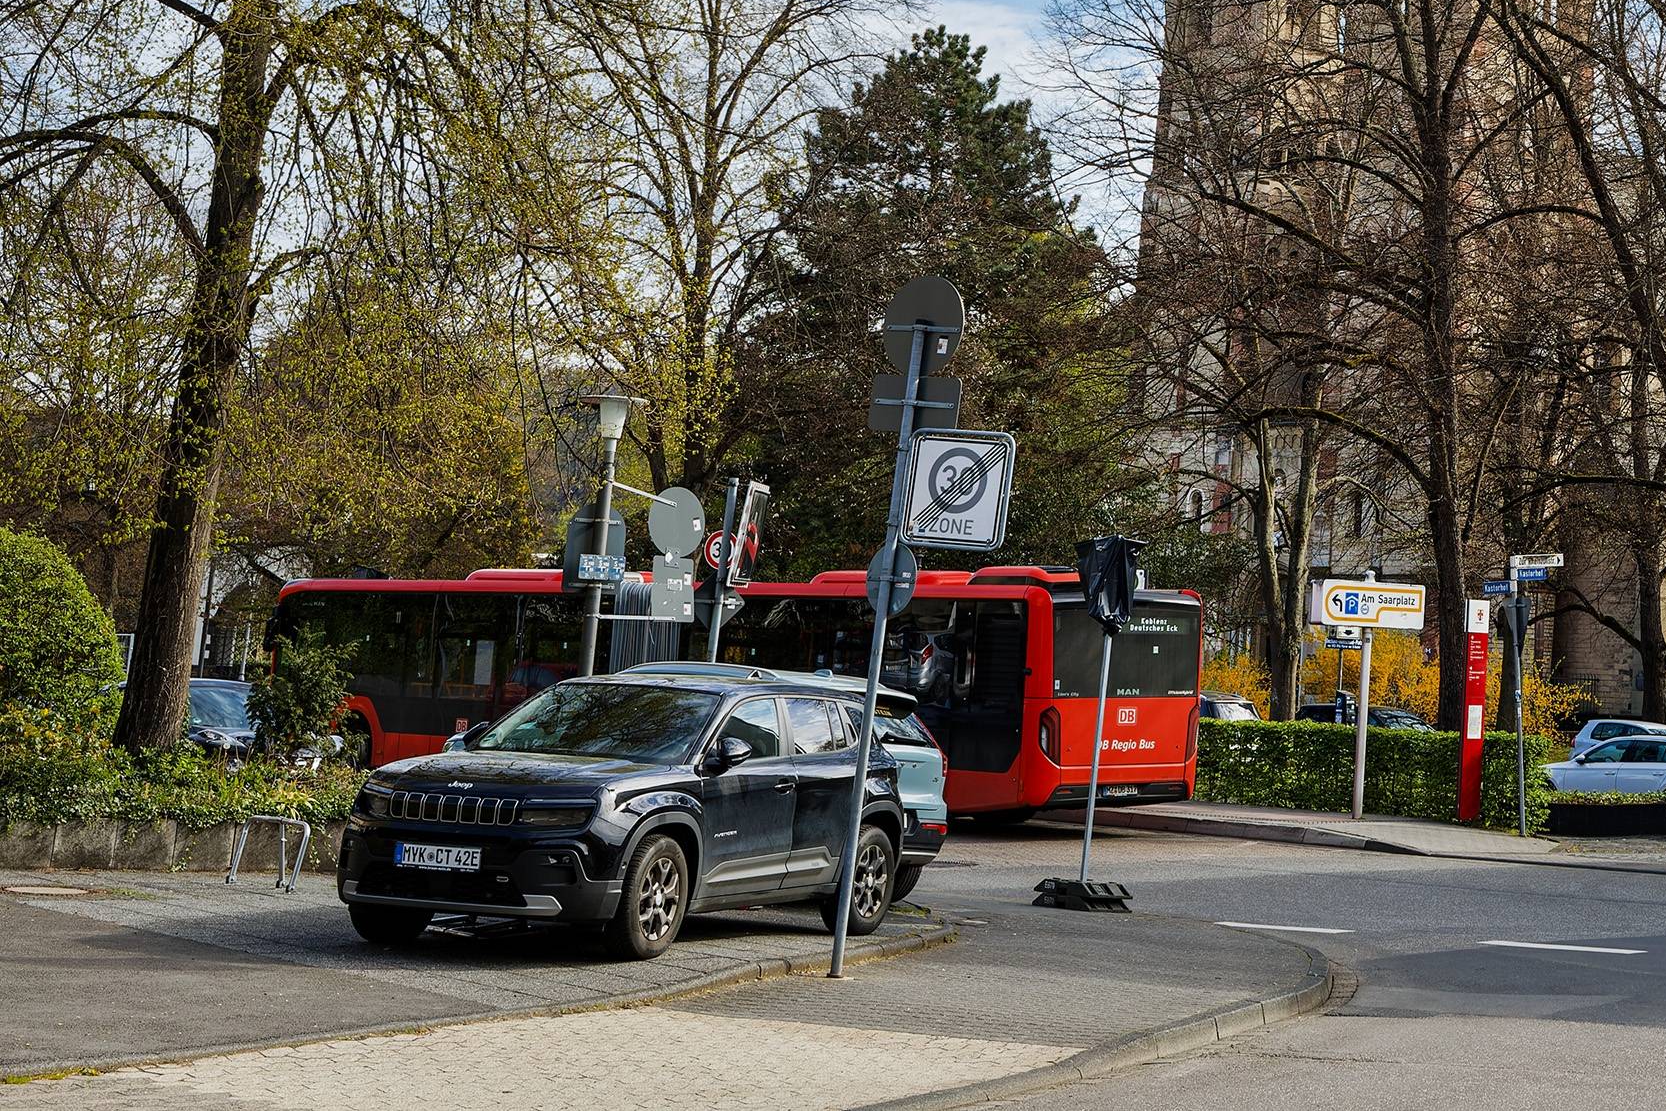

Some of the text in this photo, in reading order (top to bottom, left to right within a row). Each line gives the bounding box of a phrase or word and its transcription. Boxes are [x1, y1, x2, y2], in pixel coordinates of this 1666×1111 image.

[928, 518, 974, 536] ZONE
[1360, 593, 1416, 607] Am Saarplatz
[1141, 617, 1168, 625] Koblenz
[1129, 624, 1178, 632] Deutsches Eck
[1116, 688, 1140, 696] MAN
[1119, 710, 1135, 723] DB
[1111, 739, 1137, 752] Regio
[1139, 739, 1155, 749] Bus
[447, 780, 474, 790] Jeep
[402, 846, 480, 867] MYK CT 42E
